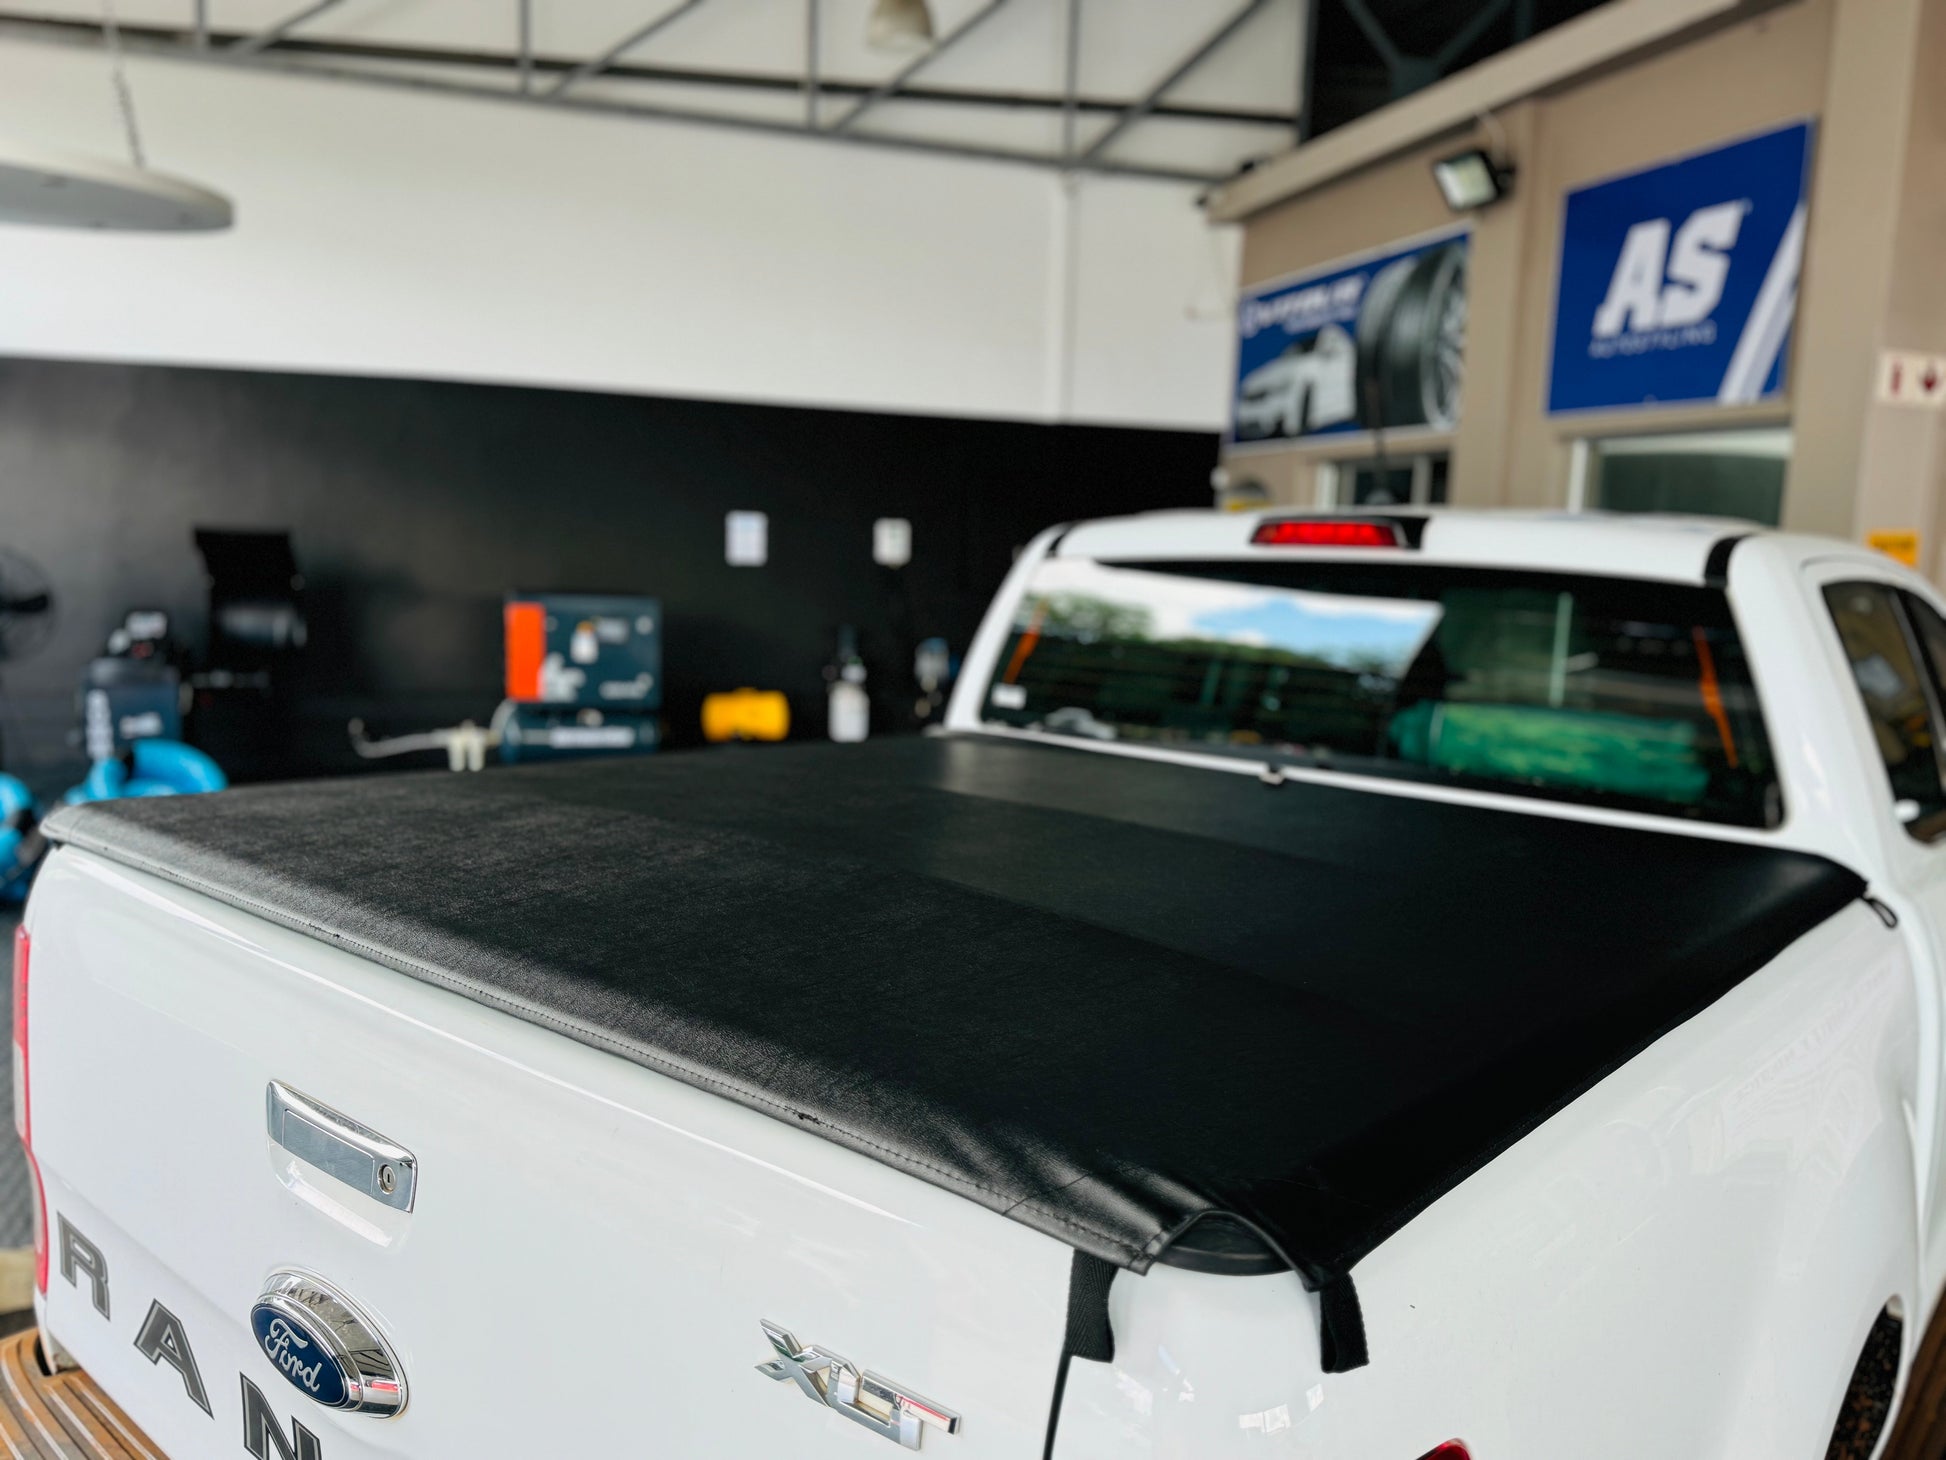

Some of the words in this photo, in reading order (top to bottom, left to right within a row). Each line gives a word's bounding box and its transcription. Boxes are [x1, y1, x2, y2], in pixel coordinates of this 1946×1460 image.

[1591, 199, 1746, 337] AS
[264, 1318, 322, 1392] Ford
[754, 1318, 961, 1451] XLT
